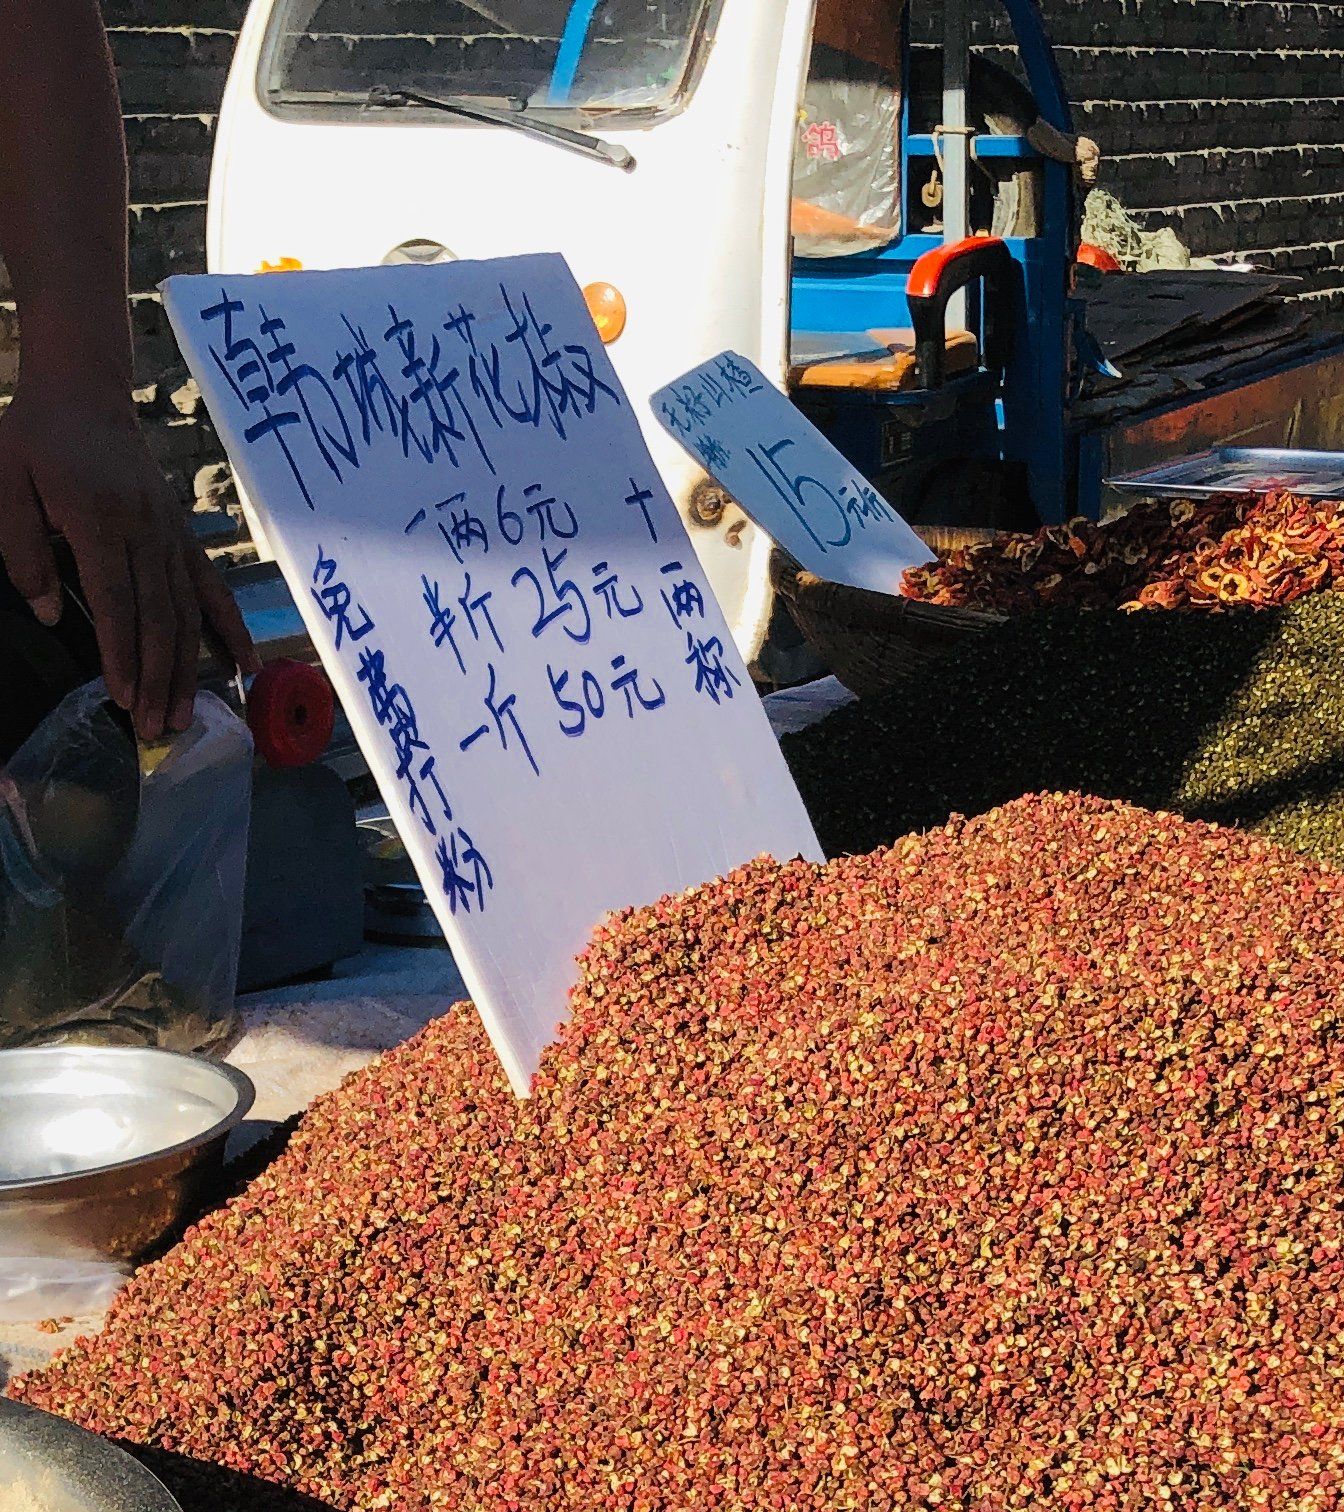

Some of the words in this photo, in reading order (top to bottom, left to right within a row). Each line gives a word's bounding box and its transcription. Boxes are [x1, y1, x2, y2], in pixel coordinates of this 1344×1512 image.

[201, 284, 620, 510] 韩城新花椒
